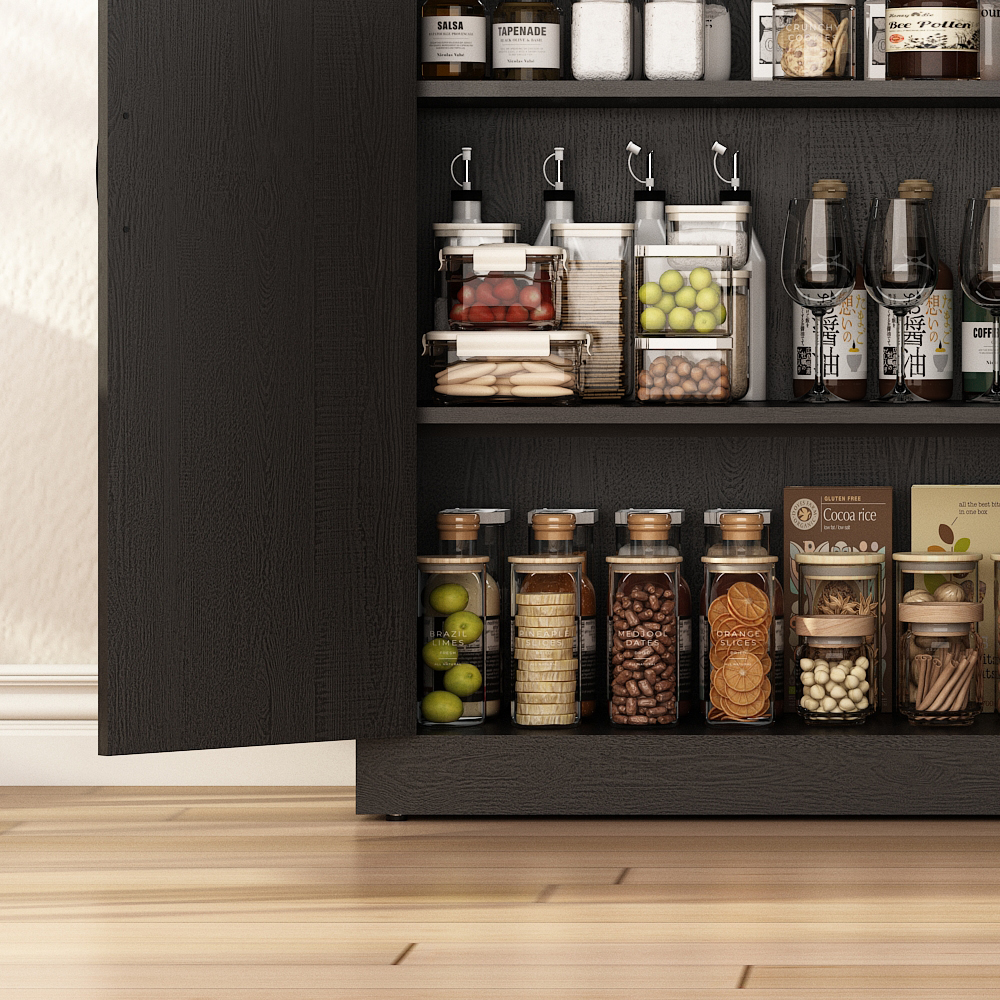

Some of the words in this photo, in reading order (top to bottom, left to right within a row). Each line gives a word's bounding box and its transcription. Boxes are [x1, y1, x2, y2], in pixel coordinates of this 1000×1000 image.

[437, 21, 464, 30] SALSA
[785, 23, 840, 32] CRUNCHY
[889, 20, 912, 29] Bee
[917, 20, 971, 29] Pollen
[498, 26, 547, 36] TAPENADE
[791, 500, 806, 517] DOVES
[806, 500, 818, 516] FARM
[823, 508, 855, 522] Cocoa
[858, 508, 877, 522] rice
[793, 517, 817, 529] ORGANIC
[429, 630, 468, 638] BRAZIL
[617, 630, 668, 638] MEDJOOL
[716, 630, 760, 638] ORANGE
[432, 639, 464, 647] LIMES
[625, 639, 660, 647] DATES
[720, 639, 757, 647] SLICES
